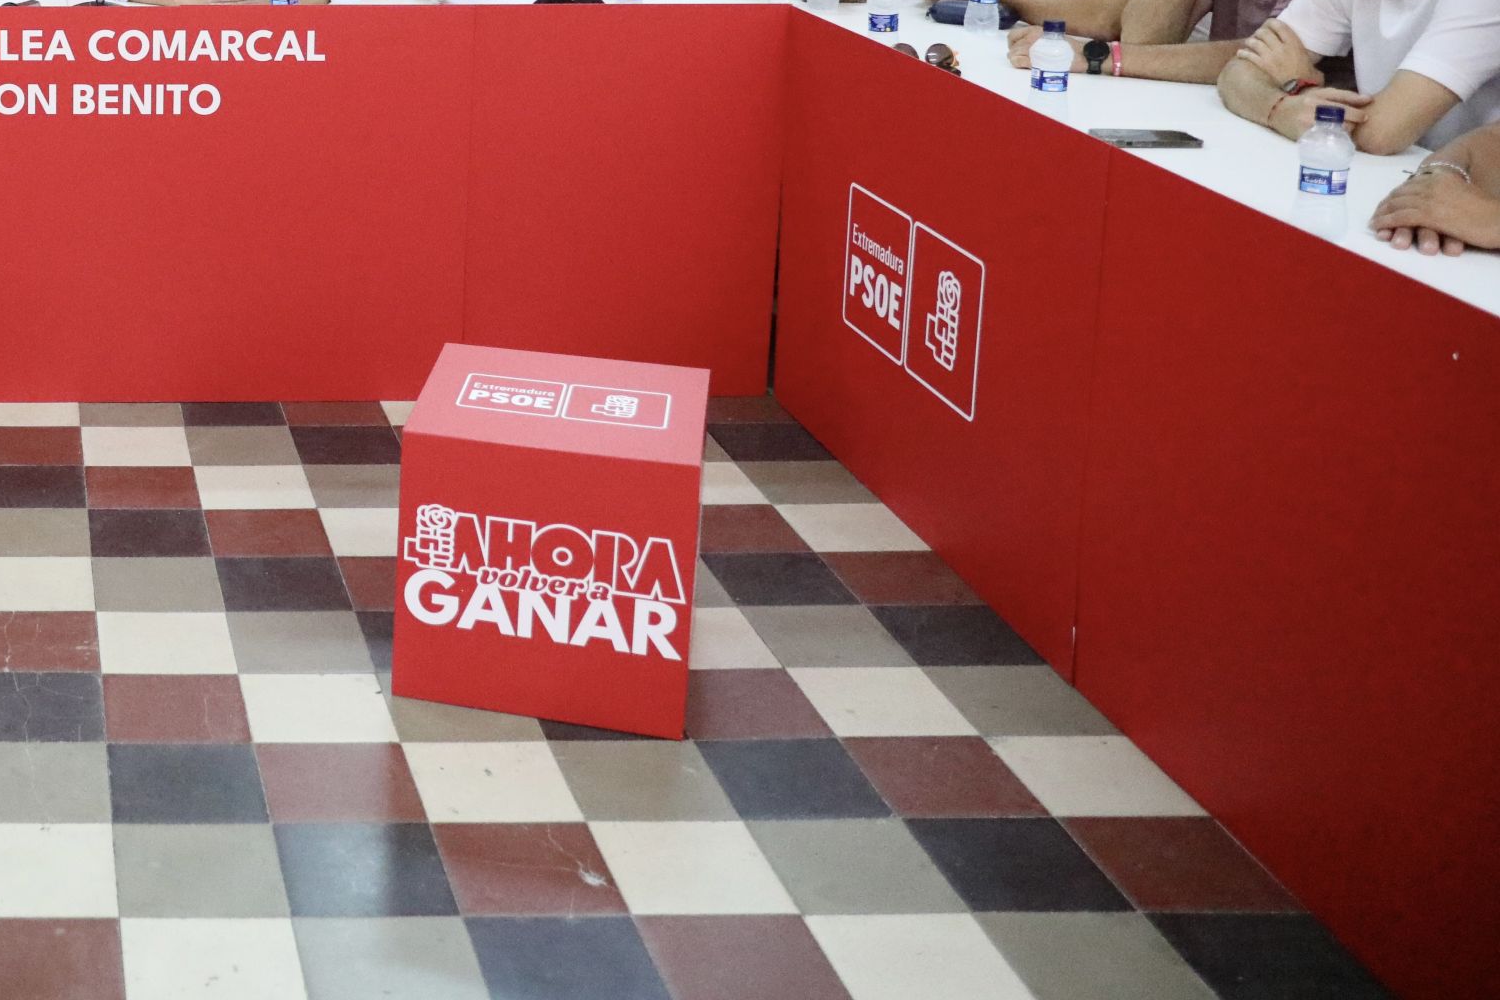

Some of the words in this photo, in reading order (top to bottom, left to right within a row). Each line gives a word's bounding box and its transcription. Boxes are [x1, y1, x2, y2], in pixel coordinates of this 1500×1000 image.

[88, 28, 326, 62] COMARCAL
[72, 83, 221, 116] BENITO
[852, 223, 904, 276] Extremadura
[849, 254, 903, 331] PSOE
[468, 389, 555, 410] PSOE
[473, 382, 556, 397] Extremadura
[451, 511, 686, 604] AHORA
[478, 566, 588, 599] volver
[587, 582, 613, 602] a
[403, 567, 682, 661] GANAR
